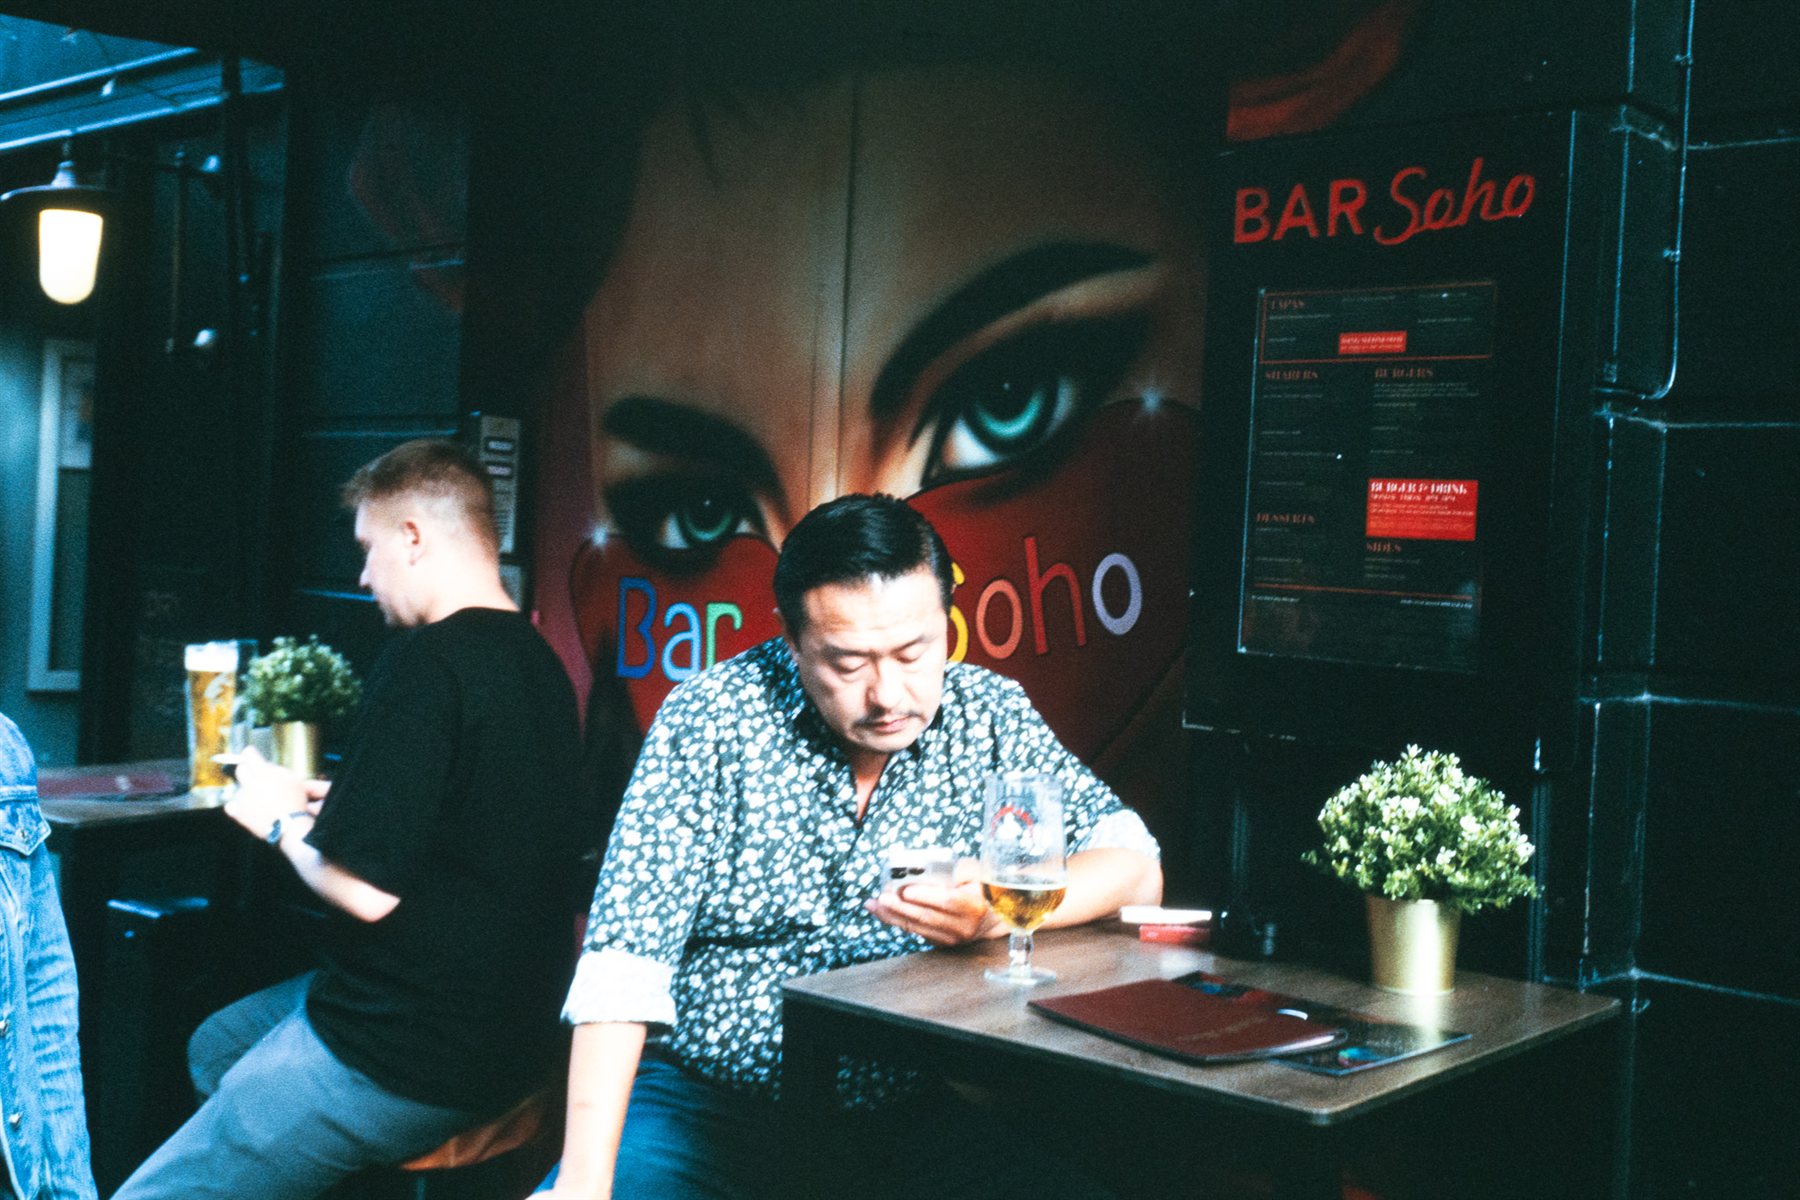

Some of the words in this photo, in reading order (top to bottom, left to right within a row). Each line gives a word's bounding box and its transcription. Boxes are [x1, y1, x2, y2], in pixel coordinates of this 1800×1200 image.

[1234, 178, 1369, 244] BAR
[1373, 156, 1536, 246] Soho
[1374, 367, 1435, 379] BURGERS
[1370, 481, 1417, 493] BURGER
[1256, 513, 1316, 524] DESSERTS
[1365, 541, 1402, 553] SIDES
[616, 576, 743, 682] Bar
